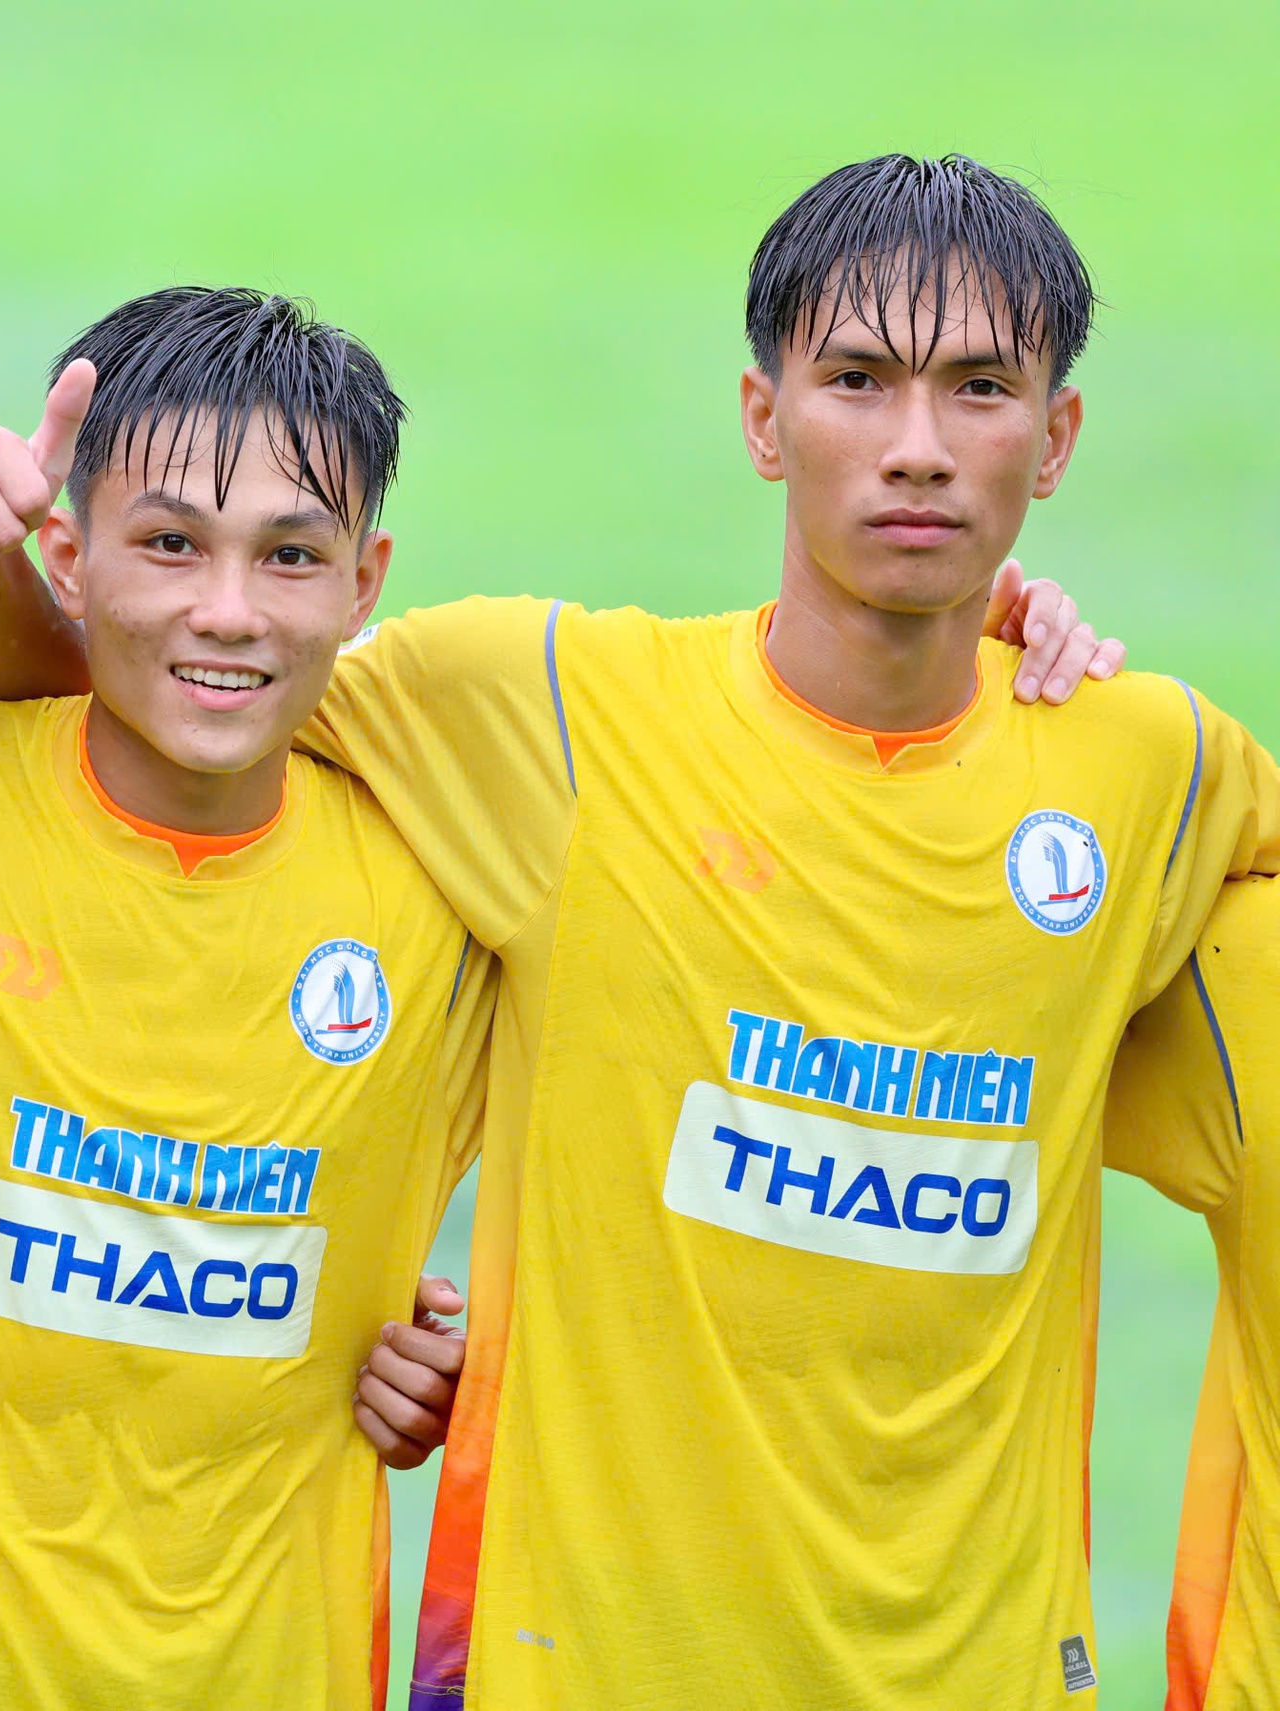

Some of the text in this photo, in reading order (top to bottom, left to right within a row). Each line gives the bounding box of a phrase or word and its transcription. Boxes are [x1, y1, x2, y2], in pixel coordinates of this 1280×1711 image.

[1063, 876, 1101, 930] UNIVERSITY
[341, 1012, 386, 1059] UNIVERSITY
[726, 1008, 1036, 1126] THANH NIÊN
[9, 1095, 322, 1215] THANH NIÊN
[712, 1124, 1011, 1237] THACO
